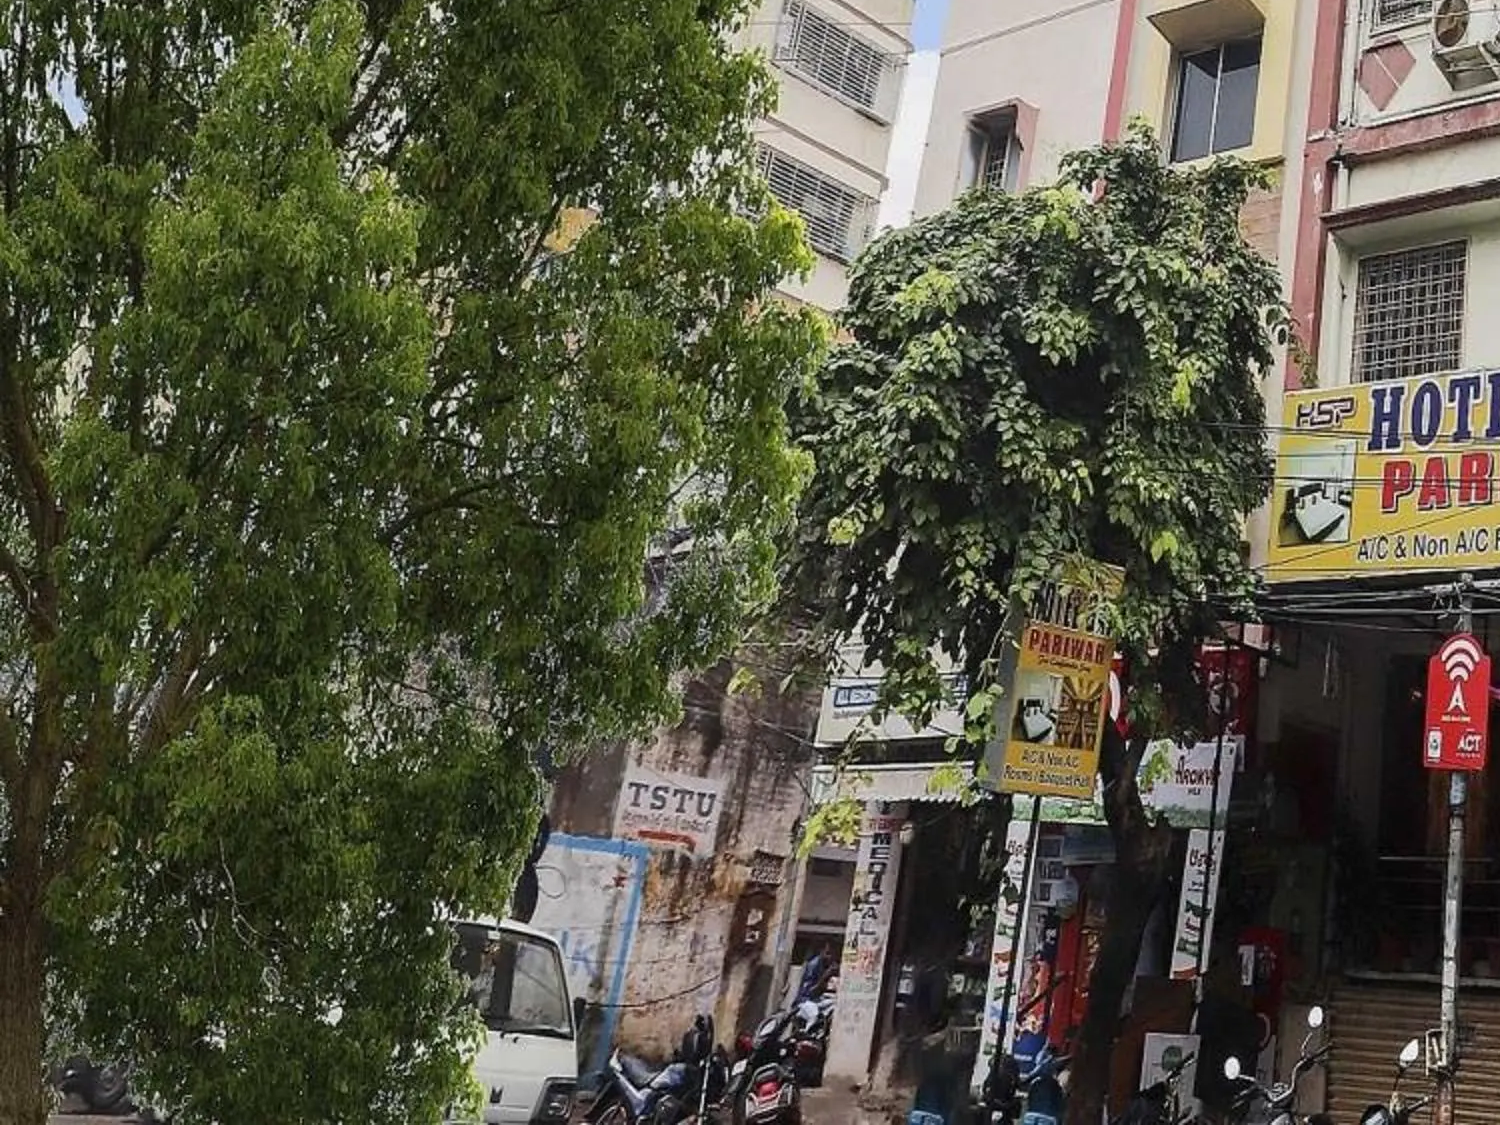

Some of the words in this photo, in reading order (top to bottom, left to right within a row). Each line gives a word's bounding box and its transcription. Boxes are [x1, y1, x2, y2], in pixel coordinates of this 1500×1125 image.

[1357, 536, 1389, 560] A/C
[1394, 534, 1407, 558] &
[1413, 534, 1449, 557] Non
[1455, 528, 1489, 554] A/C
[1029, 628, 1106, 665] PARIWAR
[1457, 734, 1482, 752] ACT
[628, 781, 717, 817] TSTU
